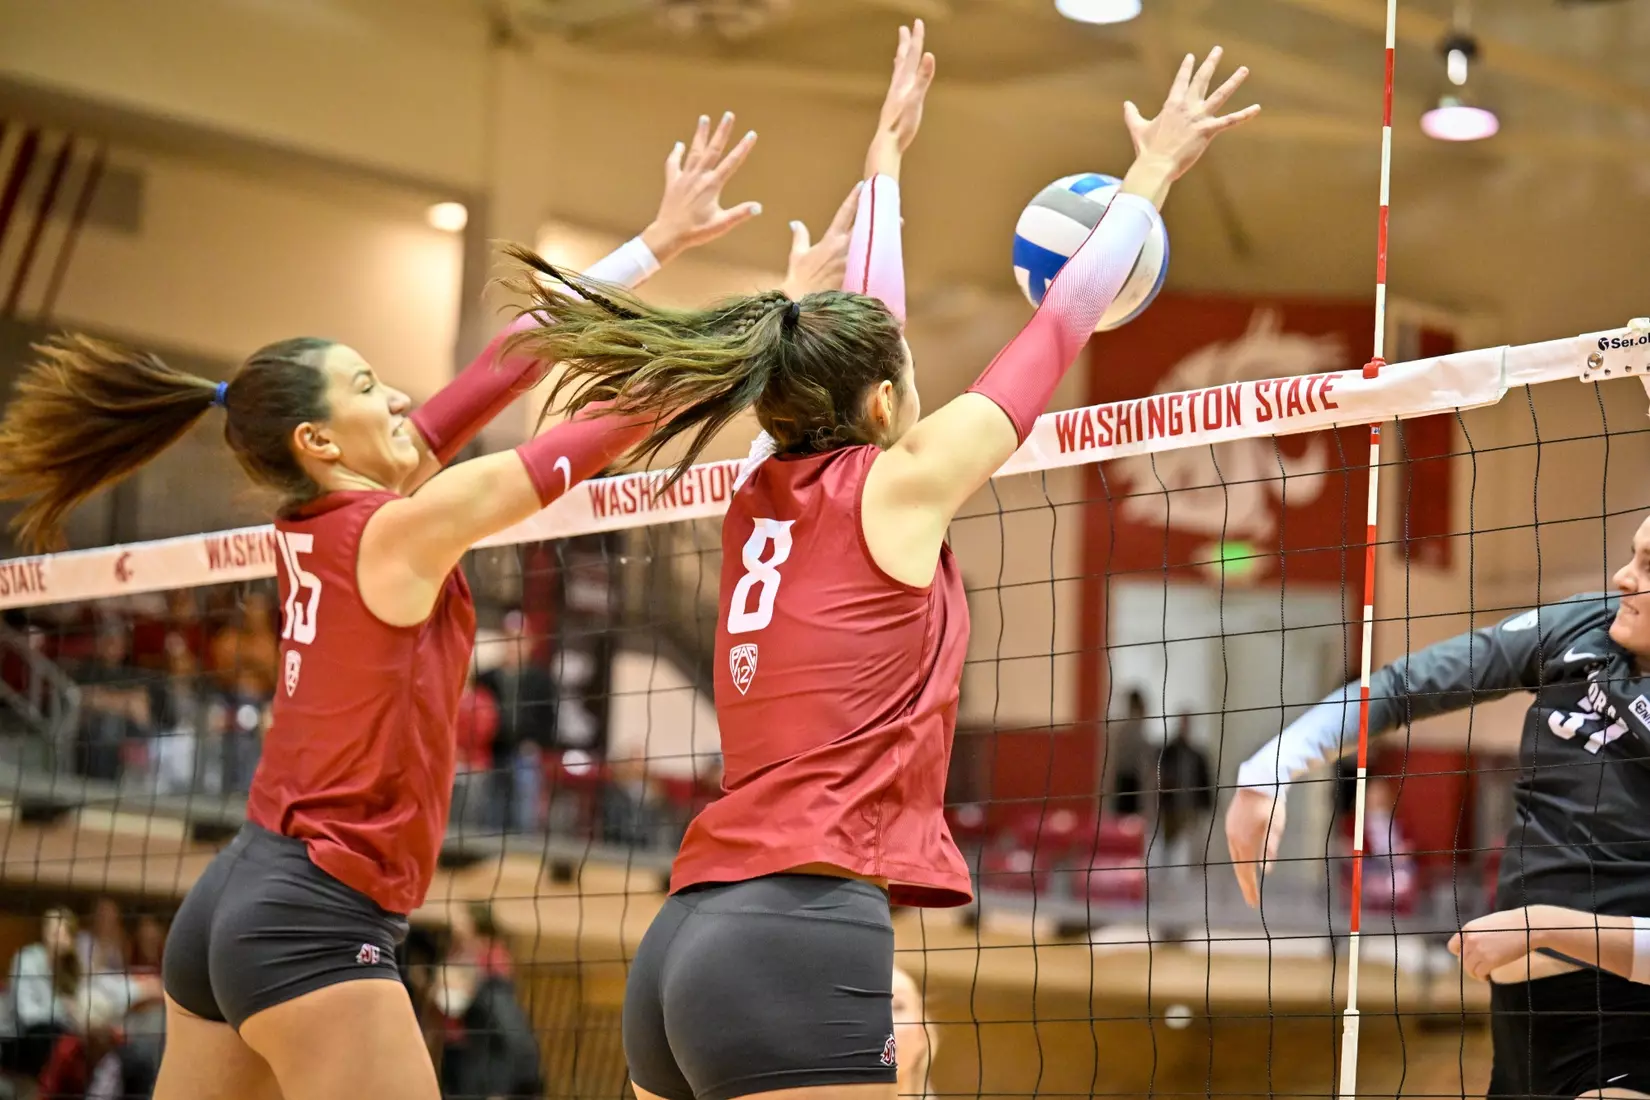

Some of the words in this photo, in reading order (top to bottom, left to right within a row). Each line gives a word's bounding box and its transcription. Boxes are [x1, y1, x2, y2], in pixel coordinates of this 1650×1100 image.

[1055, 384, 1242, 453] WASHINGTON
[1255, 374, 1343, 422] STATE
[0, 562, 46, 596] STATE
[276, 529, 322, 644] 15
[727, 517, 796, 634] 8
[731, 645, 757, 673] PAC
[736, 666, 750, 684] 12
